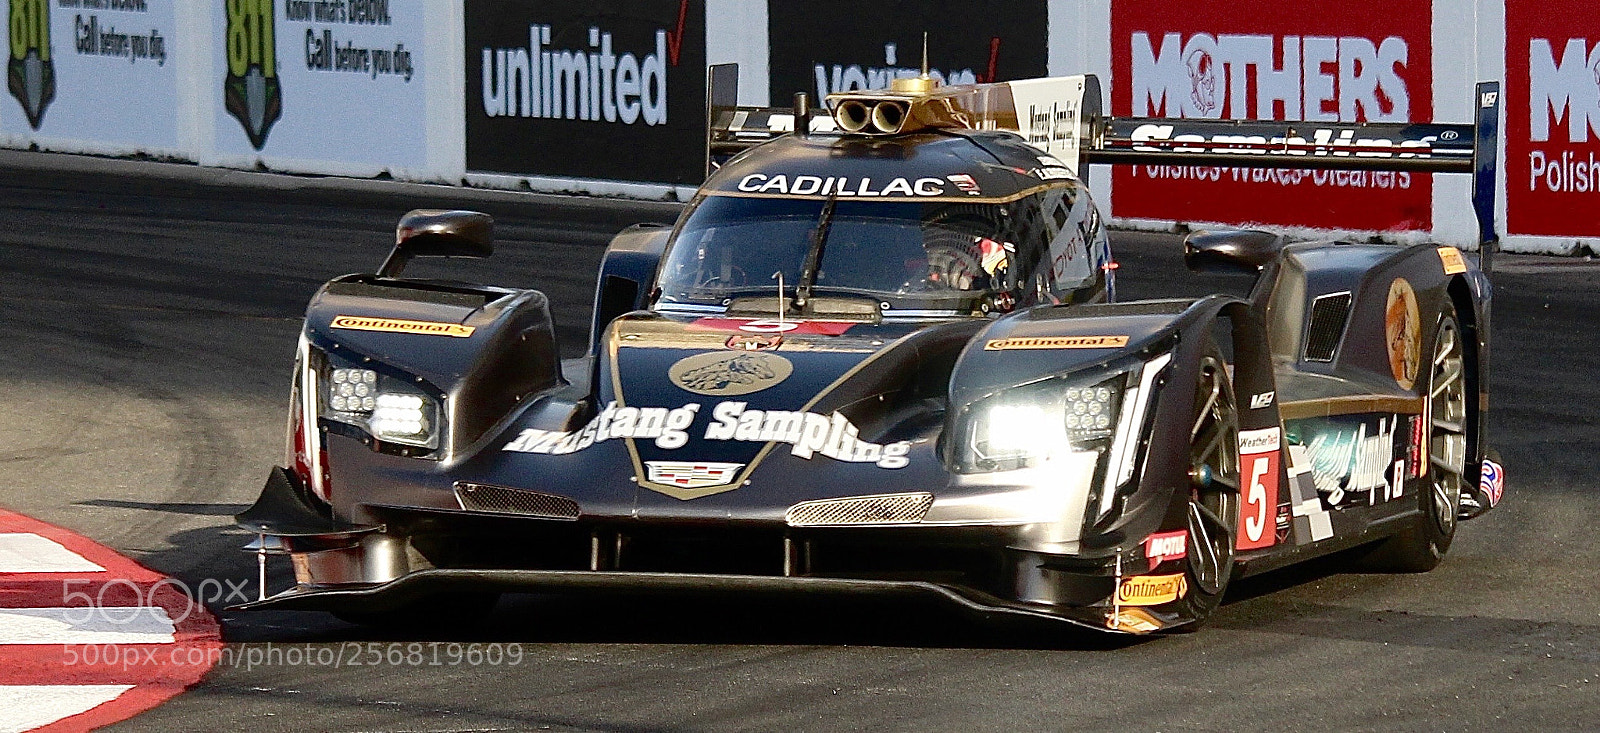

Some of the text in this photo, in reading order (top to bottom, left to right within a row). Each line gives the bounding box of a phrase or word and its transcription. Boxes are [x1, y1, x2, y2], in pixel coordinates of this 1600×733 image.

[75, 14, 98, 55] Call
[99, 26, 130, 57] before
[131, 35, 149, 64] you
[305, 28, 332, 71] Call
[334, 40, 370, 73] before
[371, 49, 393, 80] you
[482, 23, 667, 126] unlimited
[1131, 31, 1410, 123] MOTHERS
[737, 173, 946, 196] CADILLAC
[335, 317, 452, 334] Continental
[987, 337, 1105, 349] Continental
[502, 400, 912, 469] Mustang Sampling
[1244, 457, 1270, 542] 5
